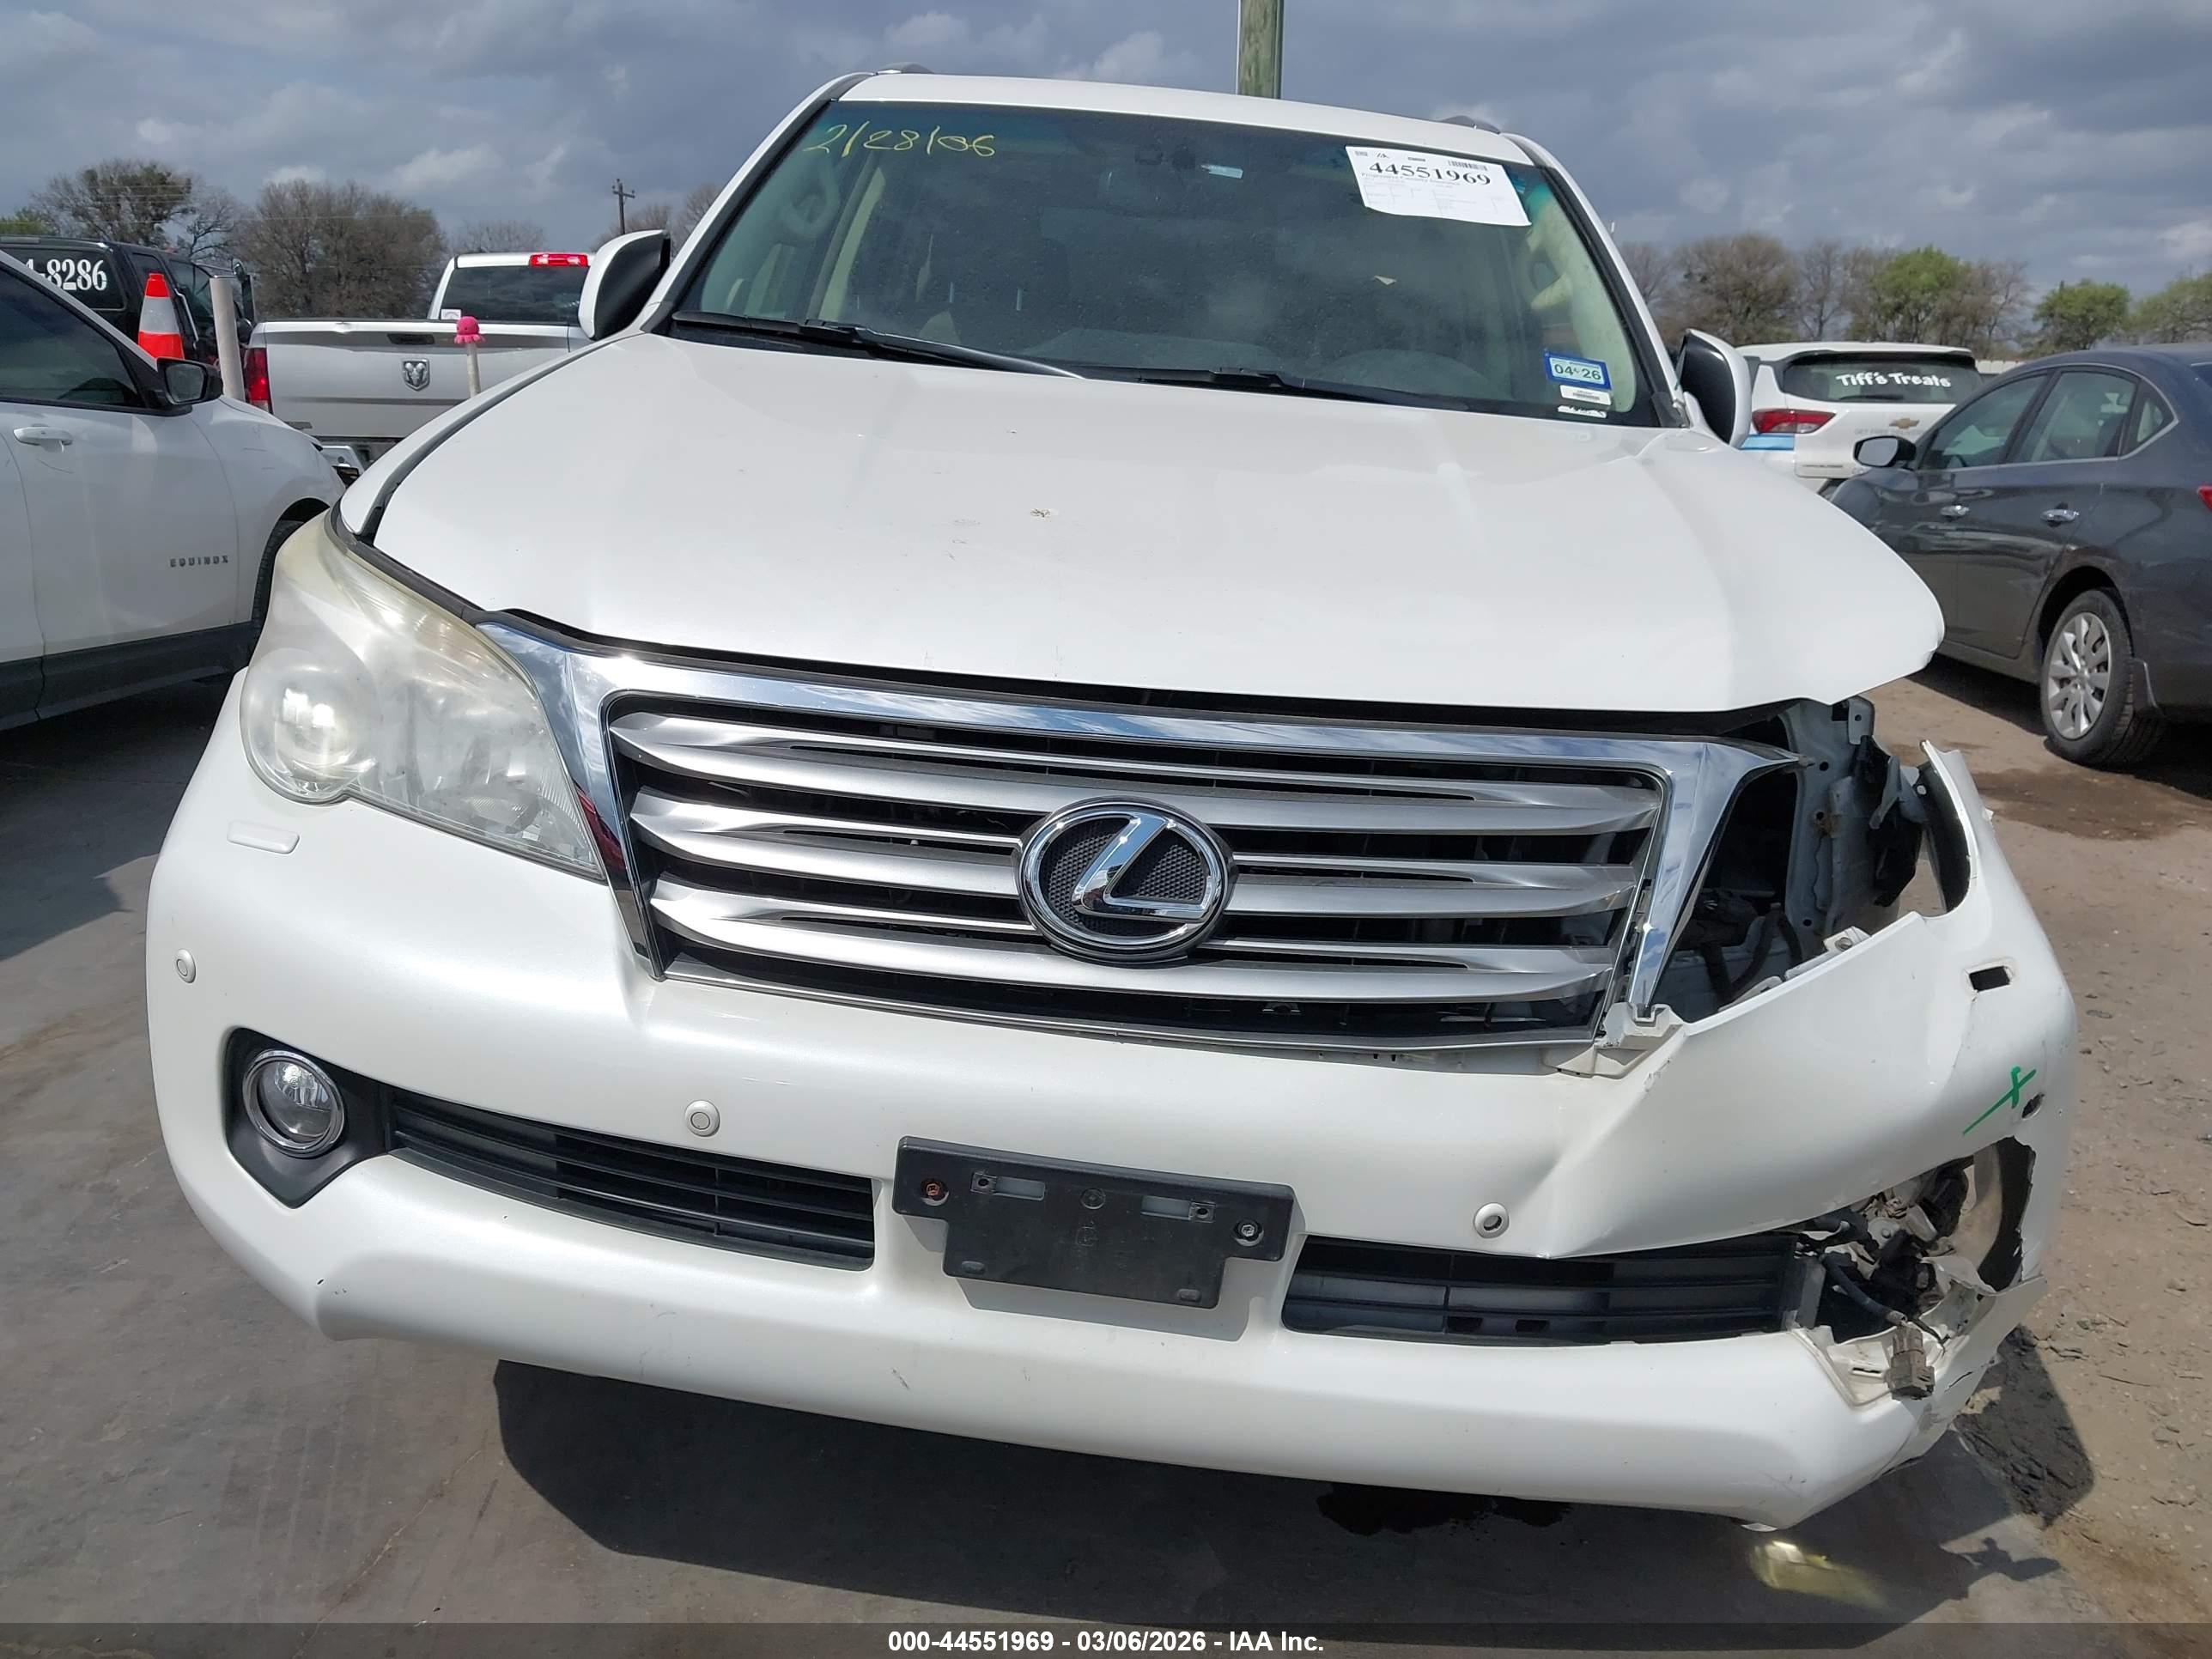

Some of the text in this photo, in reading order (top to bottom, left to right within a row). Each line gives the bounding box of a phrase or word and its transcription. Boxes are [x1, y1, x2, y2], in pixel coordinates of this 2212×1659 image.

[1369, 161, 1491, 185] 44551969
[1554, 363, 1601, 380] 04 26
[1836, 372, 1952, 387] Tiff's Treats
[170, 556, 228, 568] EQUINOX
